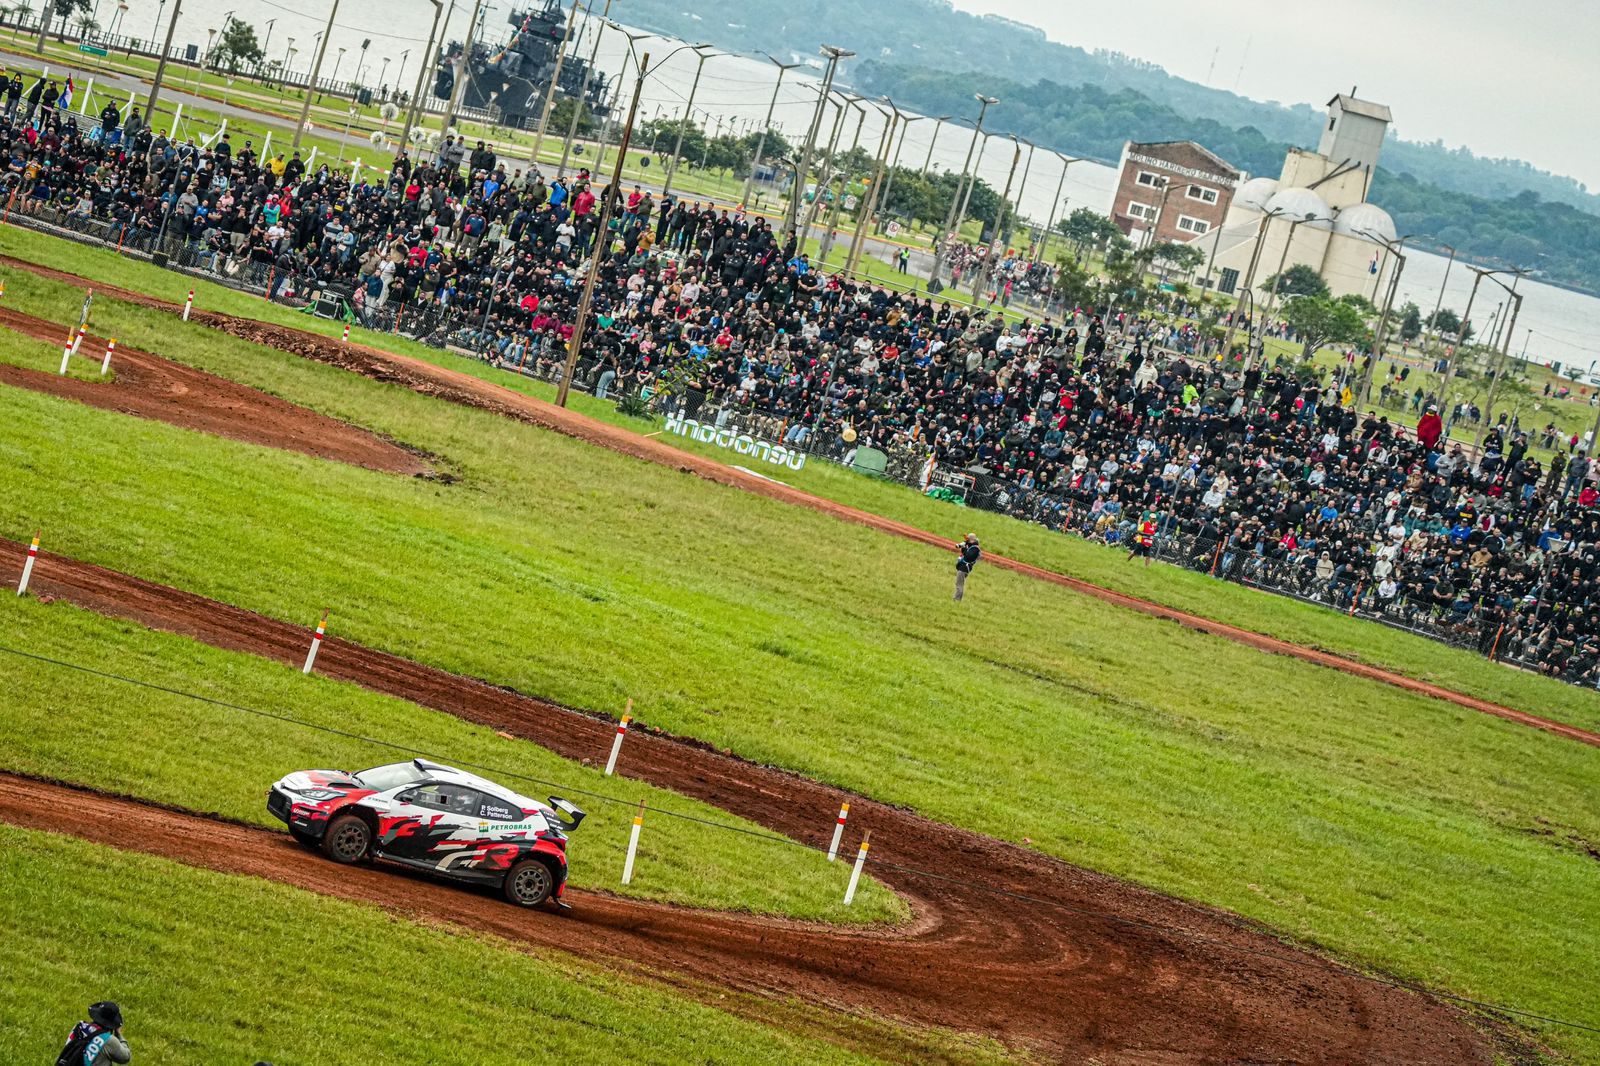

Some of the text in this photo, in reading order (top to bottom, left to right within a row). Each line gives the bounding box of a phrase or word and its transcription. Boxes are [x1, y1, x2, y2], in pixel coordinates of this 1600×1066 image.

[487, 805, 508, 814] Solberg
[487, 812, 512, 820] Patterson
[86, 1036, 104, 1061] 209
